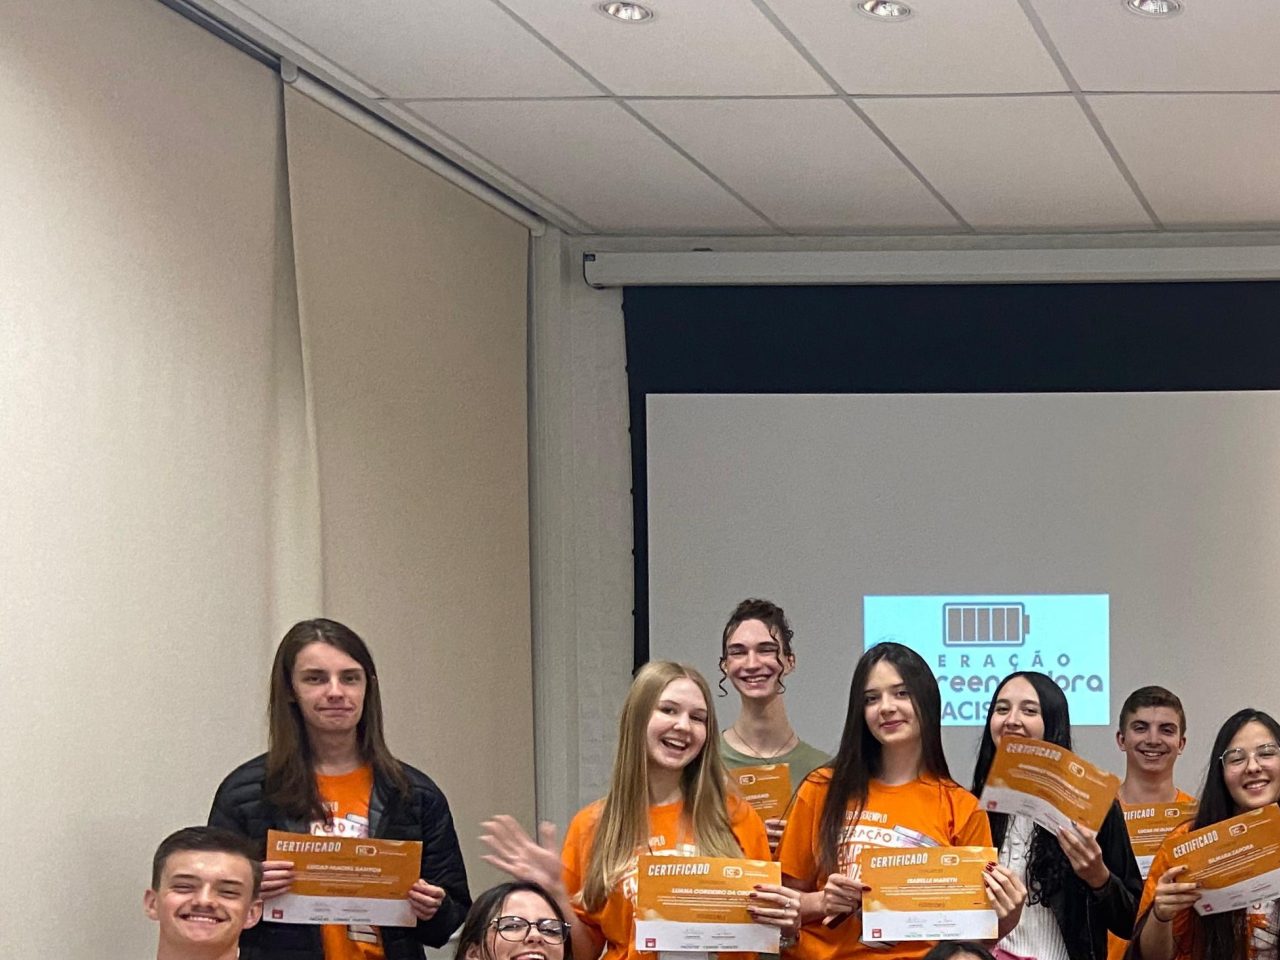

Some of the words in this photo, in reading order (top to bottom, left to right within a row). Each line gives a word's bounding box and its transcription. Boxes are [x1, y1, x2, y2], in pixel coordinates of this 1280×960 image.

[937, 650, 1070, 670] ERAÇÃO
[1124, 808, 1154, 820] TIFICADO
[276, 840, 341, 853] CERTIFICADO
[1173, 830, 1219, 858] CERTIFICADO
[870, 853, 928, 869] CERTIFICADO
[648, 863, 710, 877] CERTIFICADO
